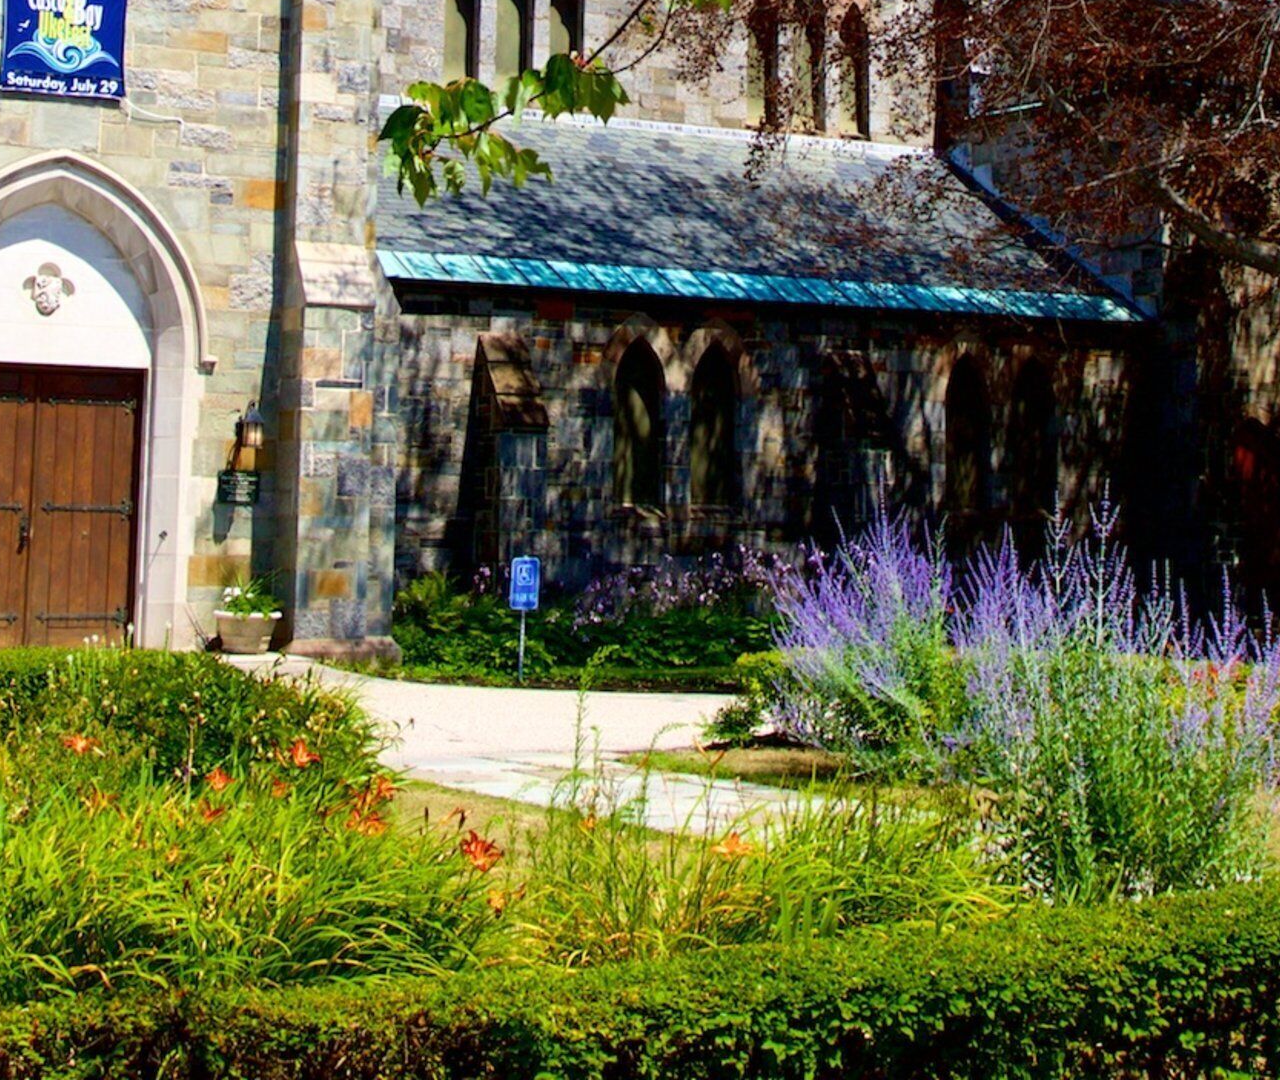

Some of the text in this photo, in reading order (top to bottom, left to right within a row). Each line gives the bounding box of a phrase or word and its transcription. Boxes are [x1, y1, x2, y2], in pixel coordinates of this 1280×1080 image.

[6, 72, 118, 95] Saturday, July 29
